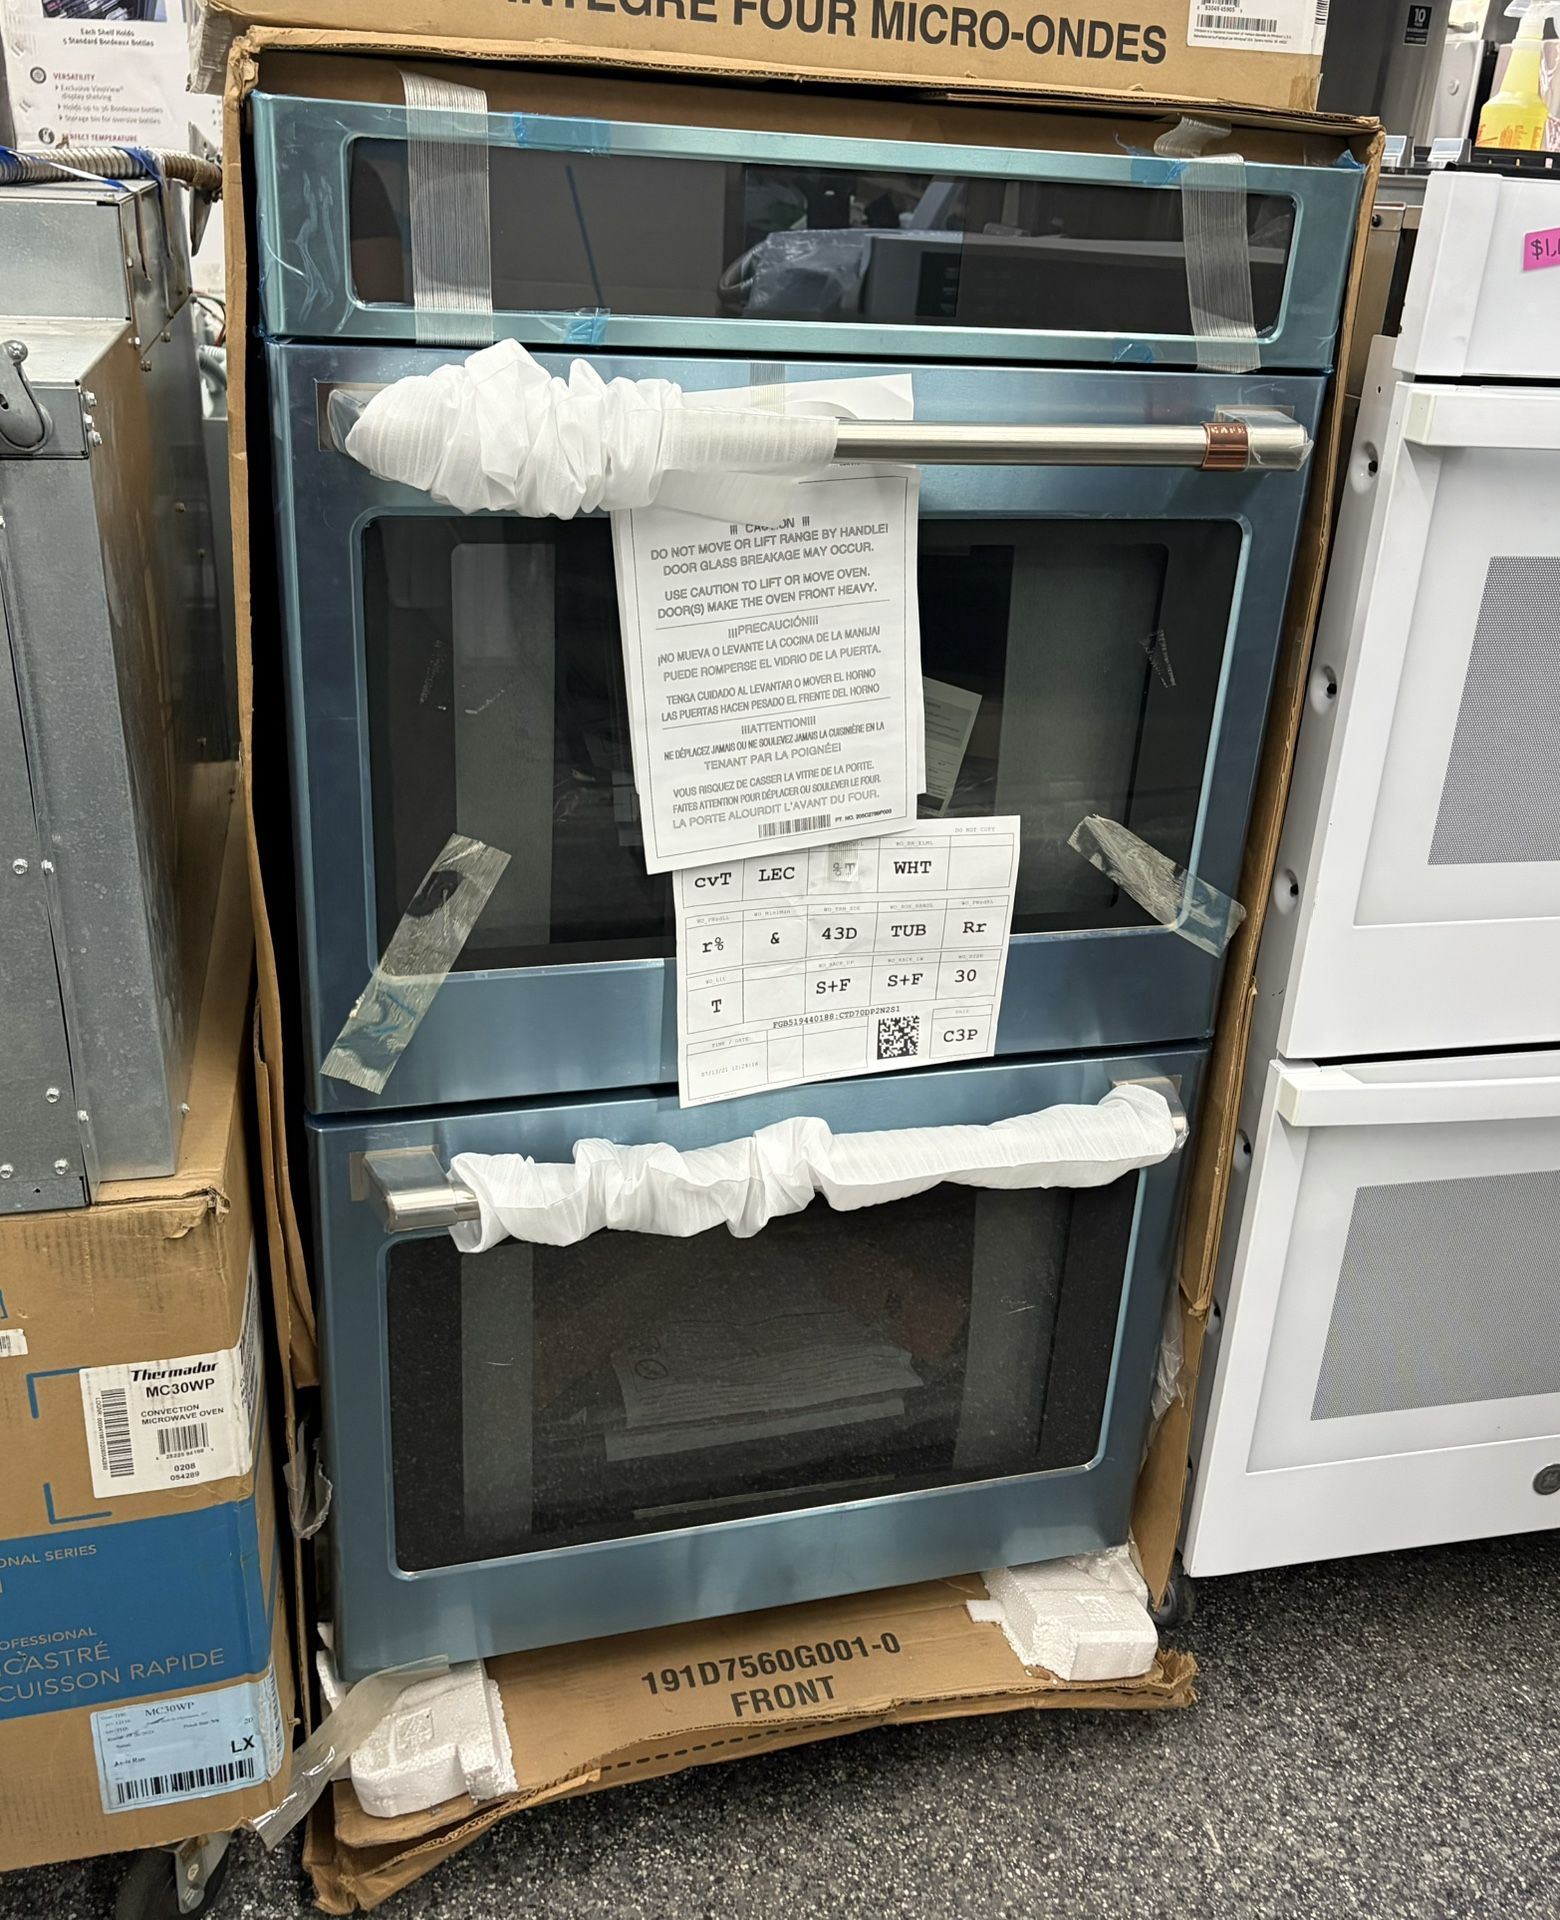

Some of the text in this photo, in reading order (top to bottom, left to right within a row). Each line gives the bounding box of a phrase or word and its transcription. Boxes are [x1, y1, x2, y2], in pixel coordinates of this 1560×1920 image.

[1414, 8, 1426, 22] 10
[69, 37, 98, 45] Standard
[100, 38, 129, 46] Bordeaux
[733, 0, 856, 36] FOUR
[871, 0, 1167, 65] MICRO-ONDES
[53, 73, 95, 81] VERSATILITY
[91, 134, 137, 142] TEMPERATURE
[651, 549, 668, 560] DO
[671, 545, 695, 558] NOT
[698, 541, 731, 554] MOVE
[734, 539, 751, 550] OR
[754, 535, 777, 547] LIFT
[780, 530, 818, 544] RANGE
[822, 528, 837, 539] BY
[663, 542, 874, 576] DOOR GLASS BREAKAGE MAY OCCUR.
[665, 567, 870, 601] USE CAUTION TO LIFT OR MOVE OVEN.
[658, 582, 877, 619] DOOR(S) MAKE THE OVEN FRONT HEAVY.
[677, 648, 710, 662] MUEVA
[712, 647, 720, 656] O
[722, 641, 764, 655] LEVANTE
[766, 640, 777, 650] LA
[779, 634, 814, 648] COCINA
[817, 632, 829, 643] DE
[831, 630, 842, 641] LA
[664, 644, 881, 681] PUEDE ROMPERSE EL VIDRIO DE LA PUERTA.
[662, 683, 879, 722] LAS PUERTAS HACEN PESADO EL FRENTE DEL HORNO
[666, 668, 876, 705] TENGA CUIDADO AL LEVANTAR O MOVER EL HORNO
[664, 751, 674, 761] NE
[675, 746, 710, 759] DÉPLACEZ
[711, 742, 736, 755] JAMAIS
[737, 741, 747, 750] OU
[748, 739, 757, 748] NE
[759, 734, 794, 747] SOULEVEZ
[795, 731, 818, 743] JAMAIS
[820, 730, 828, 739] LA
[866, 722, 875, 732] EN
[876, 721, 885, 731] LA
[704, 750, 788, 771] TENANT PAR LA
[673, 787, 697, 798] VOUS
[699, 781, 735, 794] RISQUEZ
[737, 779, 747, 789] DE
[749, 774, 782, 787] CASSER
[784, 771, 794, 781] LA
[796, 768, 819, 779] VITRE
[821, 767, 832, 776] DE
[834, 765, 844, 775] LA
[673, 802, 698, 814] FAITES
[700, 796, 739, 810] ATTENTION
[740, 793, 760, 803] POUR
[762, 786, 798, 800] DÉPLACER
[800, 784, 811, 794] OU
[812, 779, 849, 792] SOULEVER
[851, 777, 859, 787] LE
[673, 789, 879, 829] LA PORTE ALOURDIT L'AVANT DU FOUR.
[758, 861, 932, 882] LEC WHT
[770, 932, 780, 944] &
[822, 927, 857, 940] 43D
[891, 924, 927, 937] TUB
[962, 921, 987, 934] Rr
[711, 969, 977, 1013] T S+F S+F 30
[943, 1029, 978, 1042] C3P
[131, 1362, 219, 1384] Thermador
[146, 1378, 216, 1398] MC30WP
[141, 1403, 200, 1418] CONVECTION
[142, 1407, 224, 1425] MICROWAVE OVEN
[174, 1462, 196, 1472] 0208
[45, 1544, 97, 1562] SERIES
[0, 1648, 224, 1702] CUISSON RAPIDE
[641, 1632, 901, 1695] 191D7560G001-0
[145, 1702, 195, 1717] MC30WP
[730, 1675, 836, 1717] FRONT
[231, 1734, 255, 1753] LX
